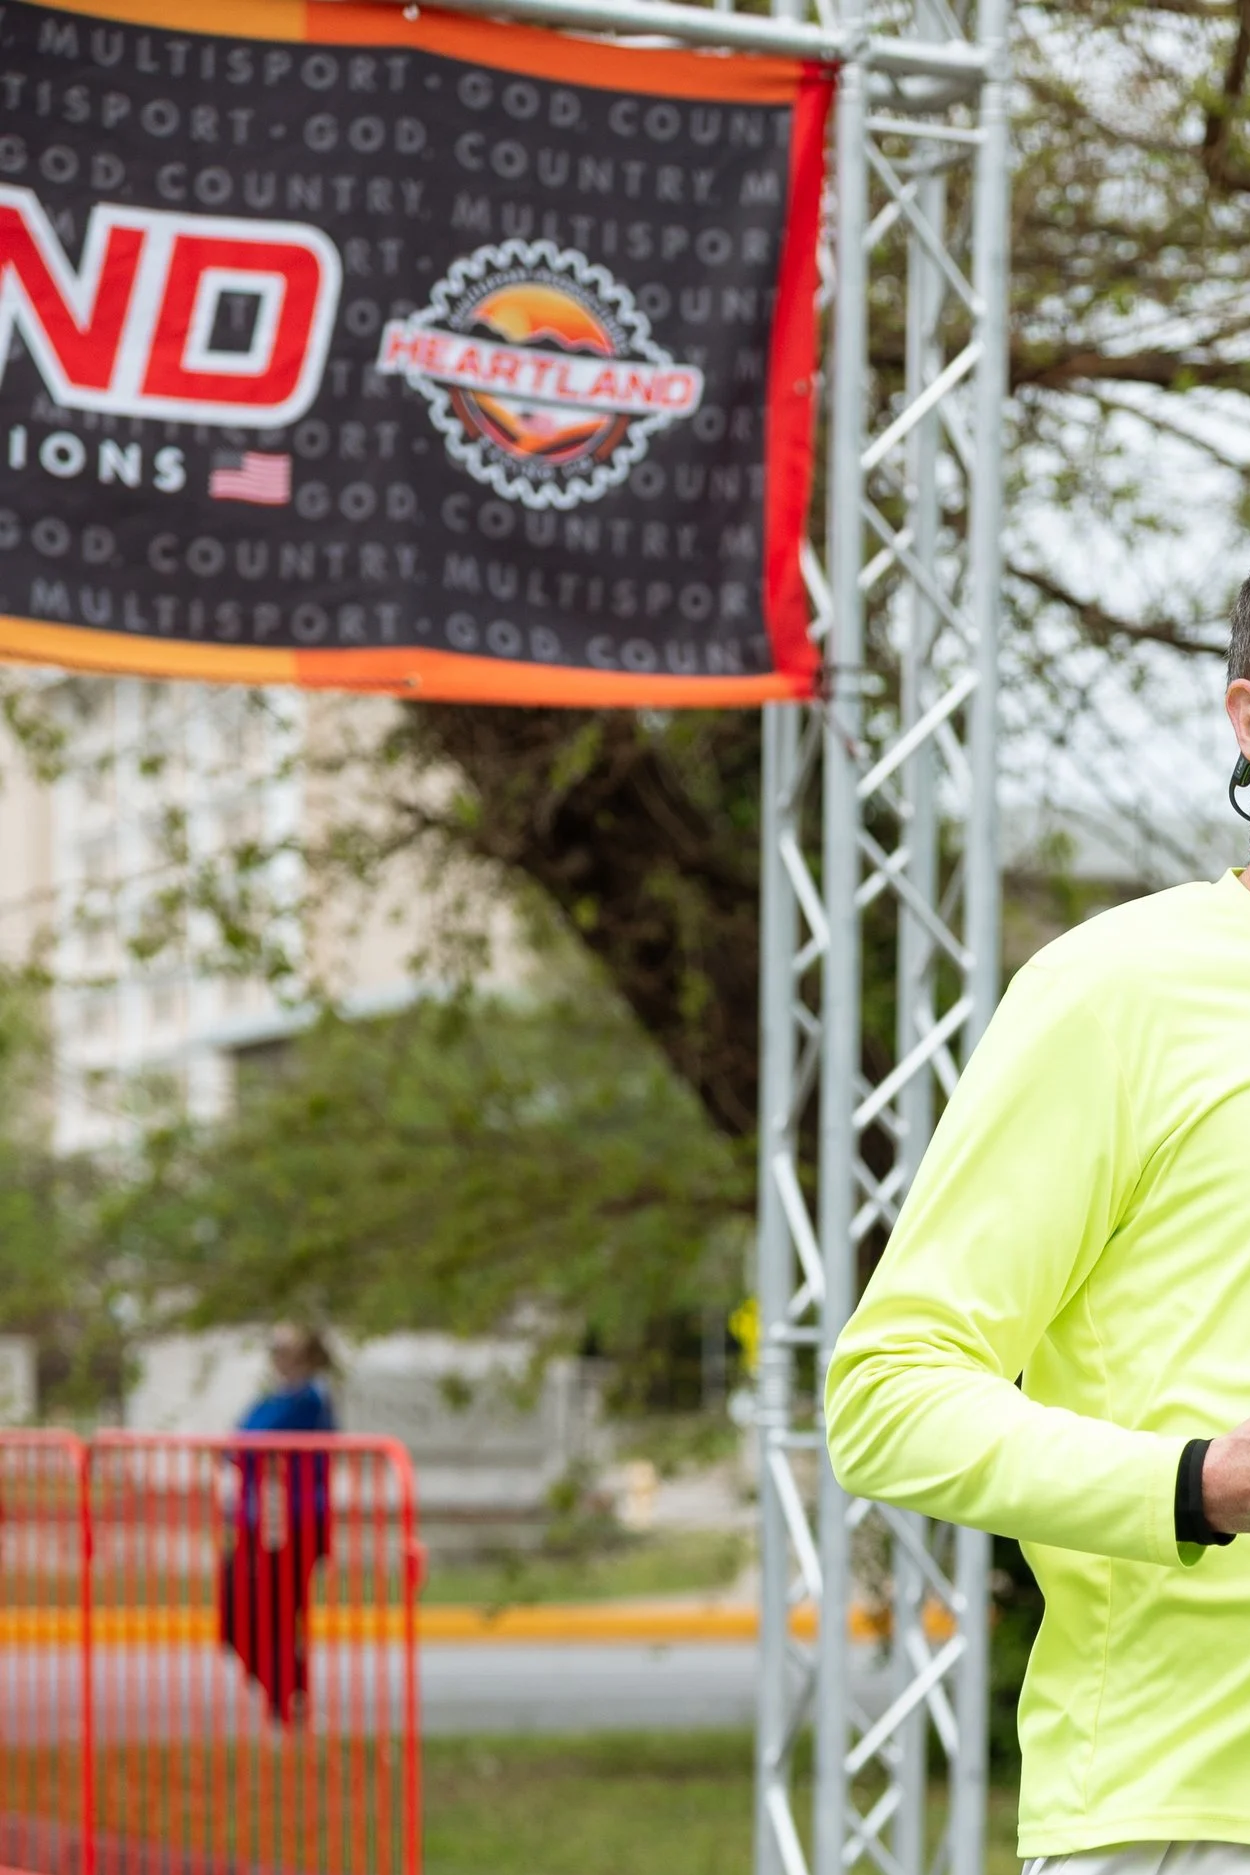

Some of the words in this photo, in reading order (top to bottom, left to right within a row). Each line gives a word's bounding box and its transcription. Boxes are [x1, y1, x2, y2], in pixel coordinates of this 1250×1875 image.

[38, 18, 411, 92] MULTISPORT
[2, 72, 256, 144] TISPORT
[382, 326, 698, 412] HEARTLAND
[7, 424, 188, 494] IONS
[30, 577, 400, 645] MULTISPORT
